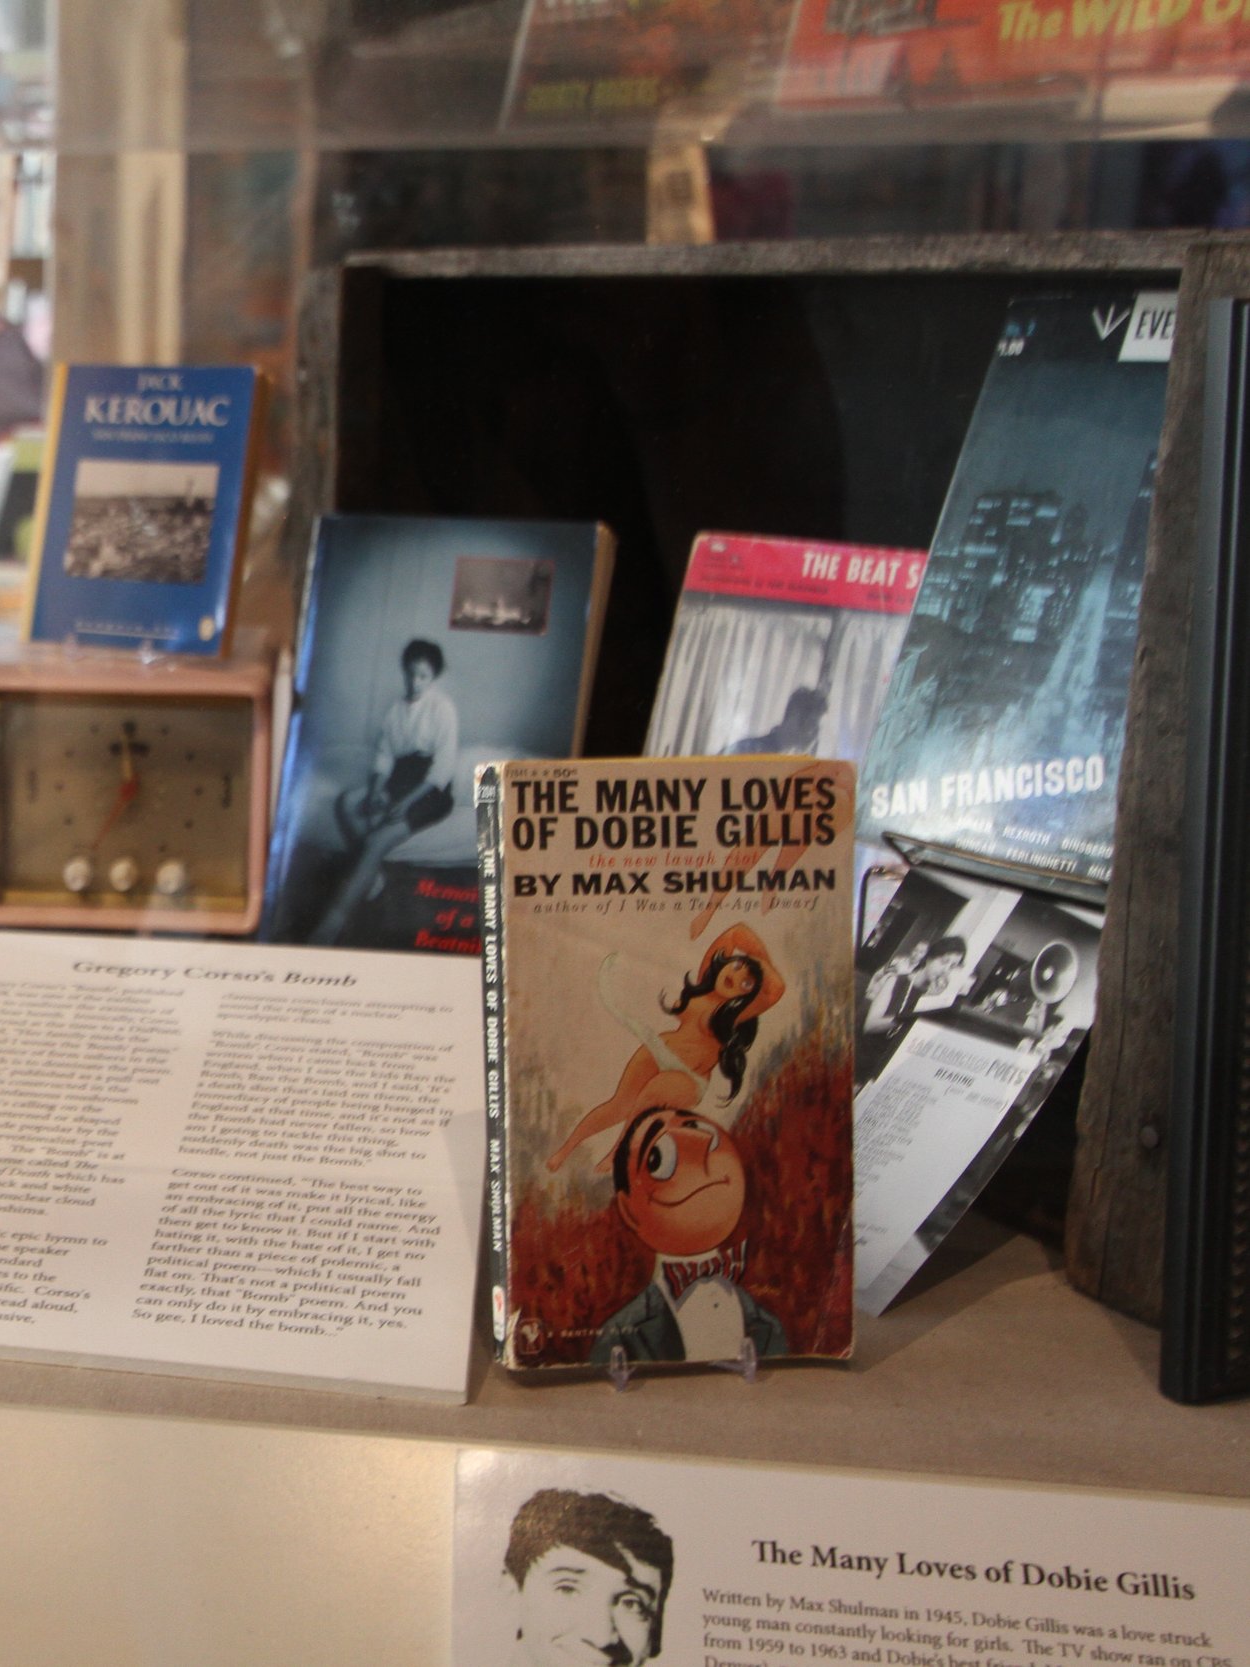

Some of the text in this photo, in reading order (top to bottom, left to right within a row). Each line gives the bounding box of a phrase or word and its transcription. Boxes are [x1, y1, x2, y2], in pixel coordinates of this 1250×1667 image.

[84, 395, 231, 427] KEROUAC
[802, 551, 841, 582] THE
[845, 555, 901, 589] BEAT
[511, 777, 836, 814] THE MANY LOVES
[870, 753, 1106, 820] SAN FRANCISCO
[512, 812, 836, 851] OF DOBIE GILLIS
[1002, 824, 1052, 846] REXROTH
[589, 854, 616, 868] the
[623, 857, 656, 868] new
[664, 851, 716, 868] laugh
[513, 868, 836, 897] BY MAX SHULMAN
[435, 906, 475, 931] of a
[534, 900, 587, 914] author
[596, 900, 612, 915] of
[636, 899, 666, 912] Was
[768, 895, 820, 912] Dwarf
[72, 961, 358, 987] Gregory Corso's Bomb
[484, 851, 502, 1252] THE MANY LOVES OF DOBIE GILLIS MAX SHULMAN
[934, 1068, 975, 1088] READING
[139, 1283, 197, 1297] exactly,
[201, 1287, 231, 1298] that
[299, 1297, 349, 1309] poem.
[354, 1300, 388, 1312] And
[393, 1306, 423, 1316] you
[143, 1268, 168, 1278] flat
[201, 1272, 245, 1285] That's
[250, 1278, 276, 1288] not
[293, 1281, 356, 1295] political
[360, 1288, 406, 1300] poem
[31, 1301, 78, 1313] aloud,
[132, 1308, 152, 1319] So
[155, 1314, 186, 1324] gee,
[201, 1314, 245, 1328] loved
[249, 1319, 274, 1331] the
[135, 1296, 407, 1329] can only do it by embracing it, yes.
[751, 1540, 1196, 1601] The Many Loves of Dobie Gillis
[703, 1588, 1211, 1649] Written by Max Shulman in 1945, Dobie Gillis was a love struck
[703, 1614, 750, 1632] young
[756, 1618, 790, 1632] man
[795, 1621, 876, 1643] constantly
[881, 1626, 942, 1648] looking
[947, 1632, 969, 1648] for
[974, 1636, 1013, 1653] girls.
[1022, 1639, 1053, 1656] The
[1057, 1642, 1084, 1657] TV
[1090, 1646, 1132, 1662] show
[1138, 1653, 1165, 1665] ran
[1170, 1657, 1191, 1667] on
[704, 1632, 742, 1650] from
[748, 1637, 784, 1653] 1959
[789, 1643, 805, 1655] to
[811, 1643, 847, 1659] 1963
[852, 1648, 882, 1663] and
[887, 1650, 944, 1667] Dobie's
